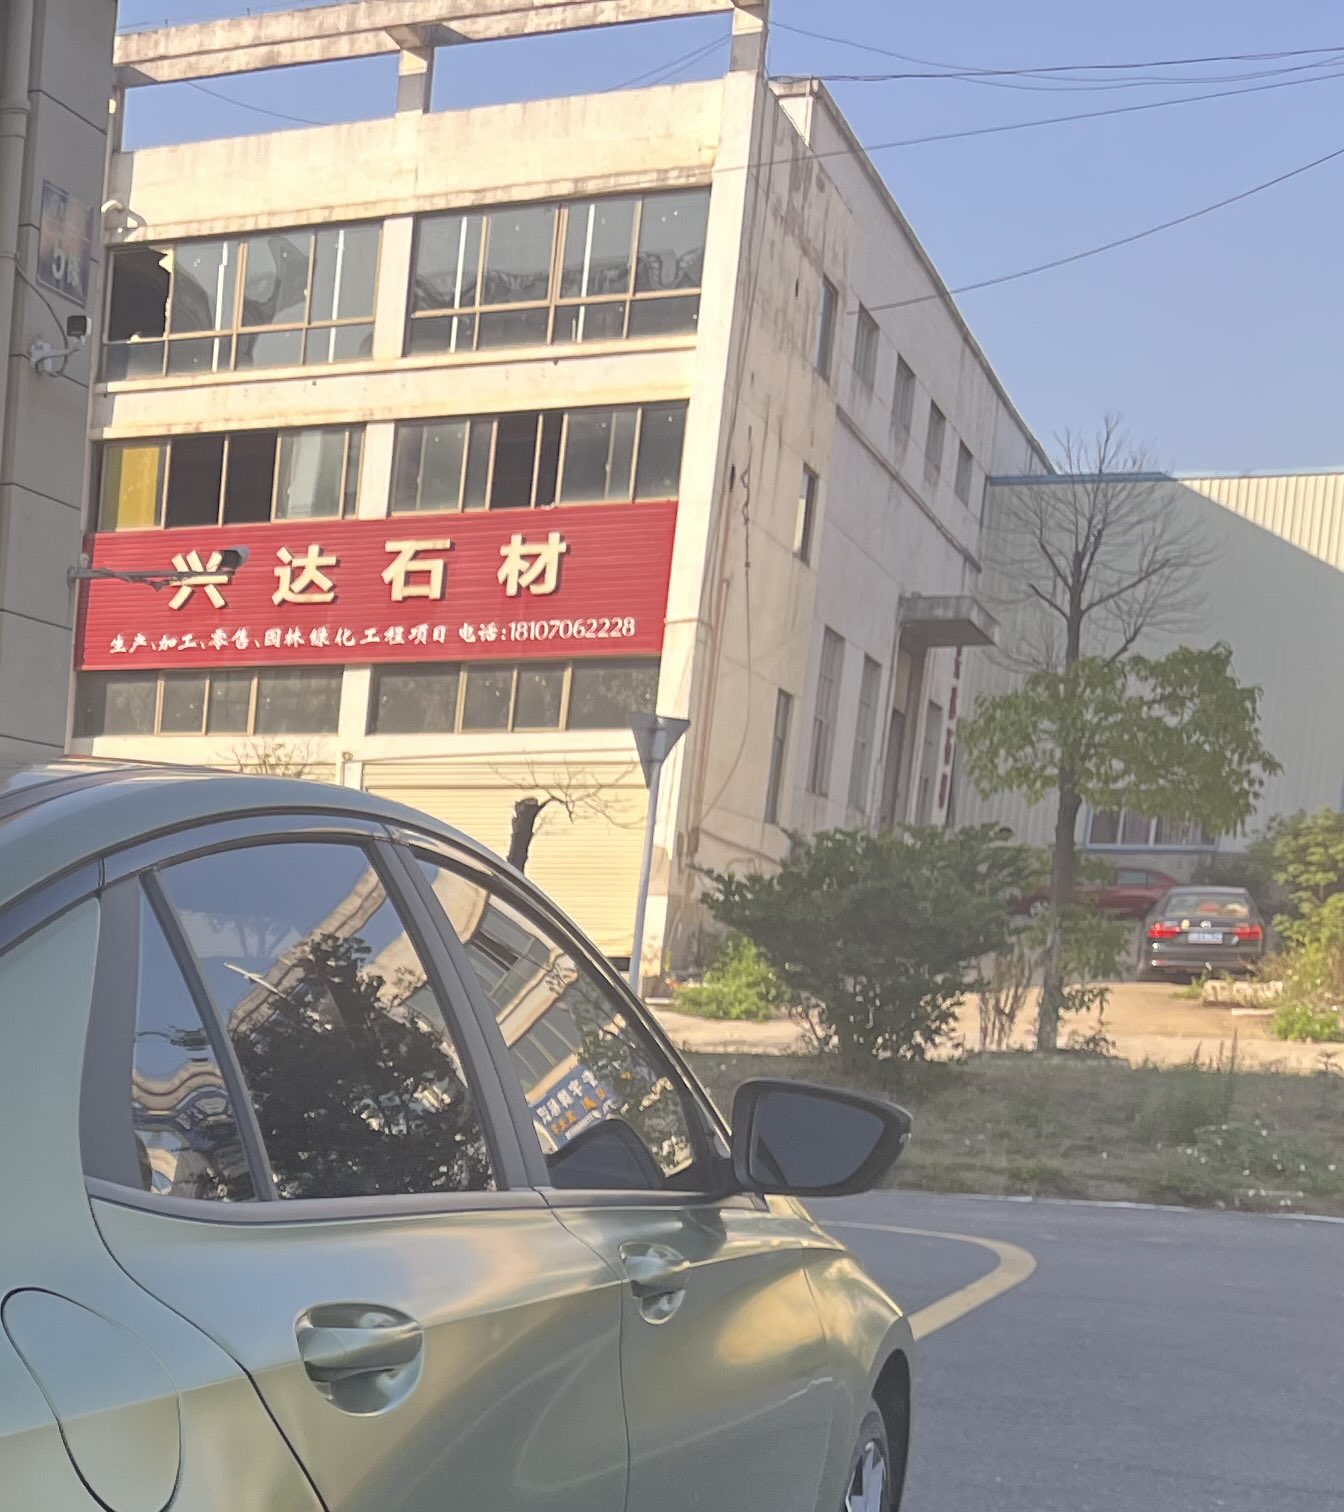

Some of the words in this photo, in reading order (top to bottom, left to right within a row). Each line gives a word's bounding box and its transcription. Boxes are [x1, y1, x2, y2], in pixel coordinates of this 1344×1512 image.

[168, 531, 569, 610] 兴达石材
[459, 616, 636, 644] 电话:18107062228
